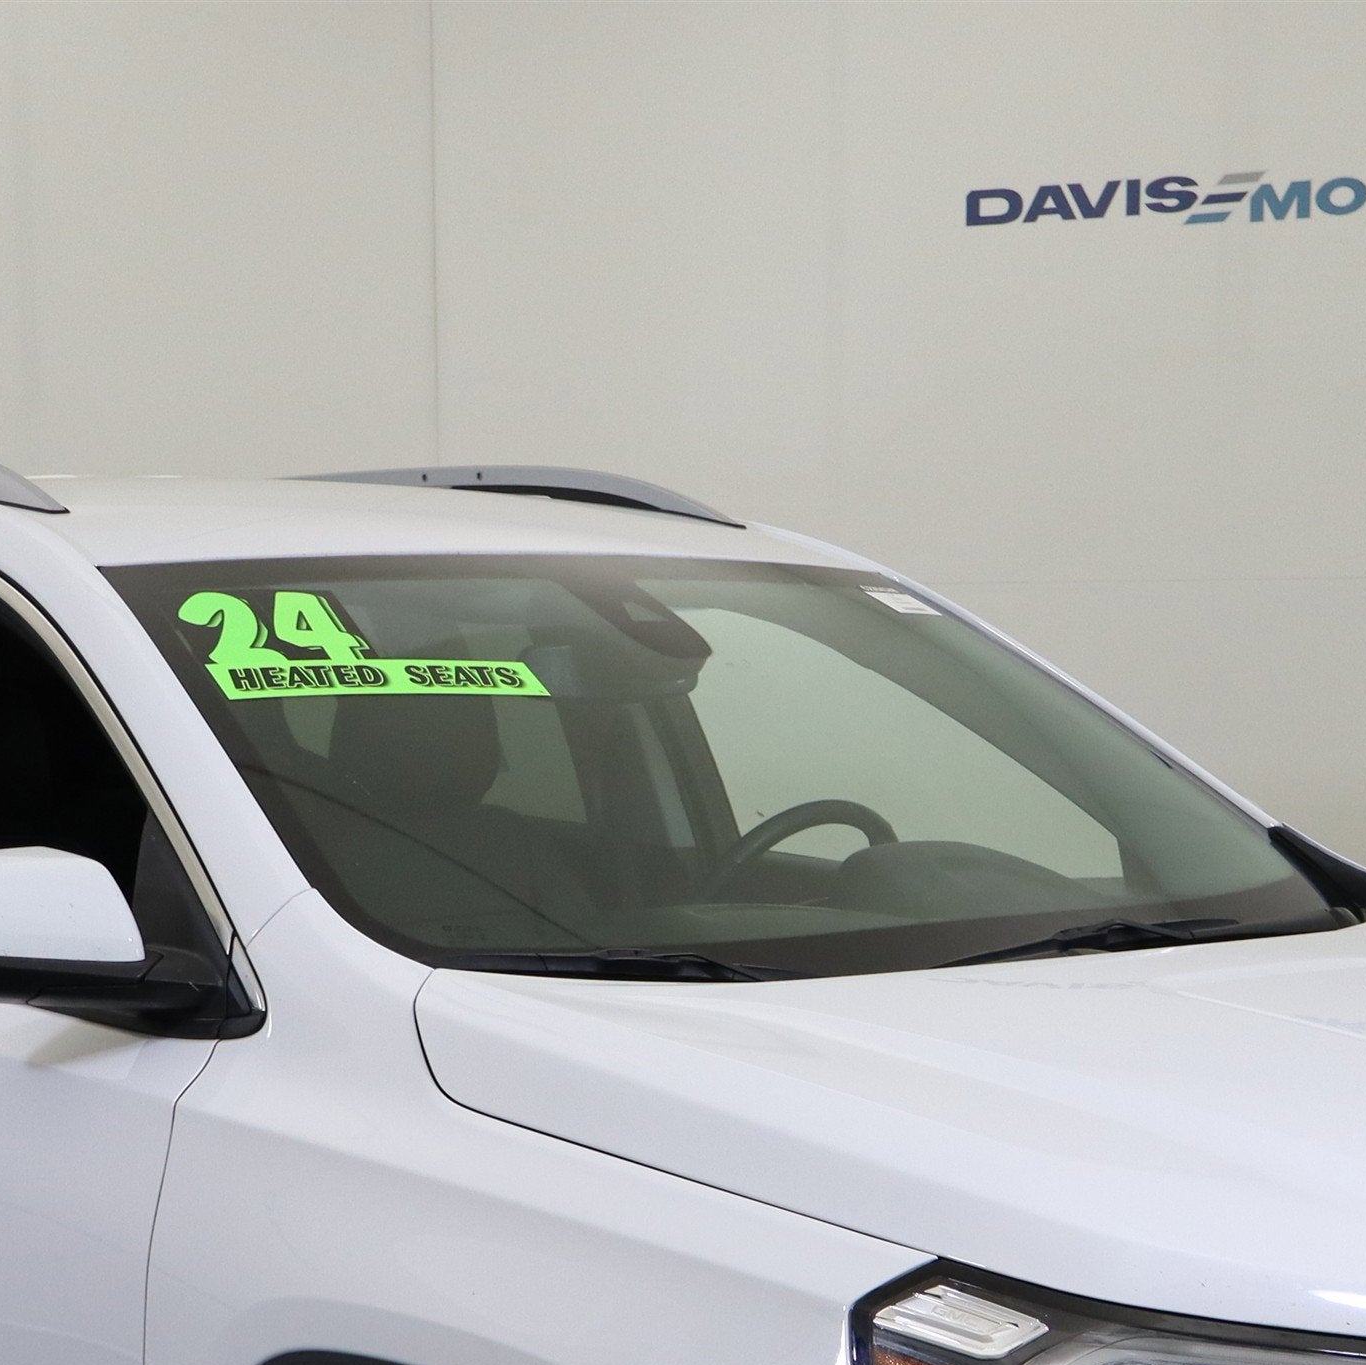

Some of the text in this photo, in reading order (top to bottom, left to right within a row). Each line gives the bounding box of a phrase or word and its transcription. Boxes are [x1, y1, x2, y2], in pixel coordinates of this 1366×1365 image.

[966, 175, 1199, 226] DAVIS
[177, 590, 369, 664] 24
[228, 663, 525, 691] HEATED SEATS
